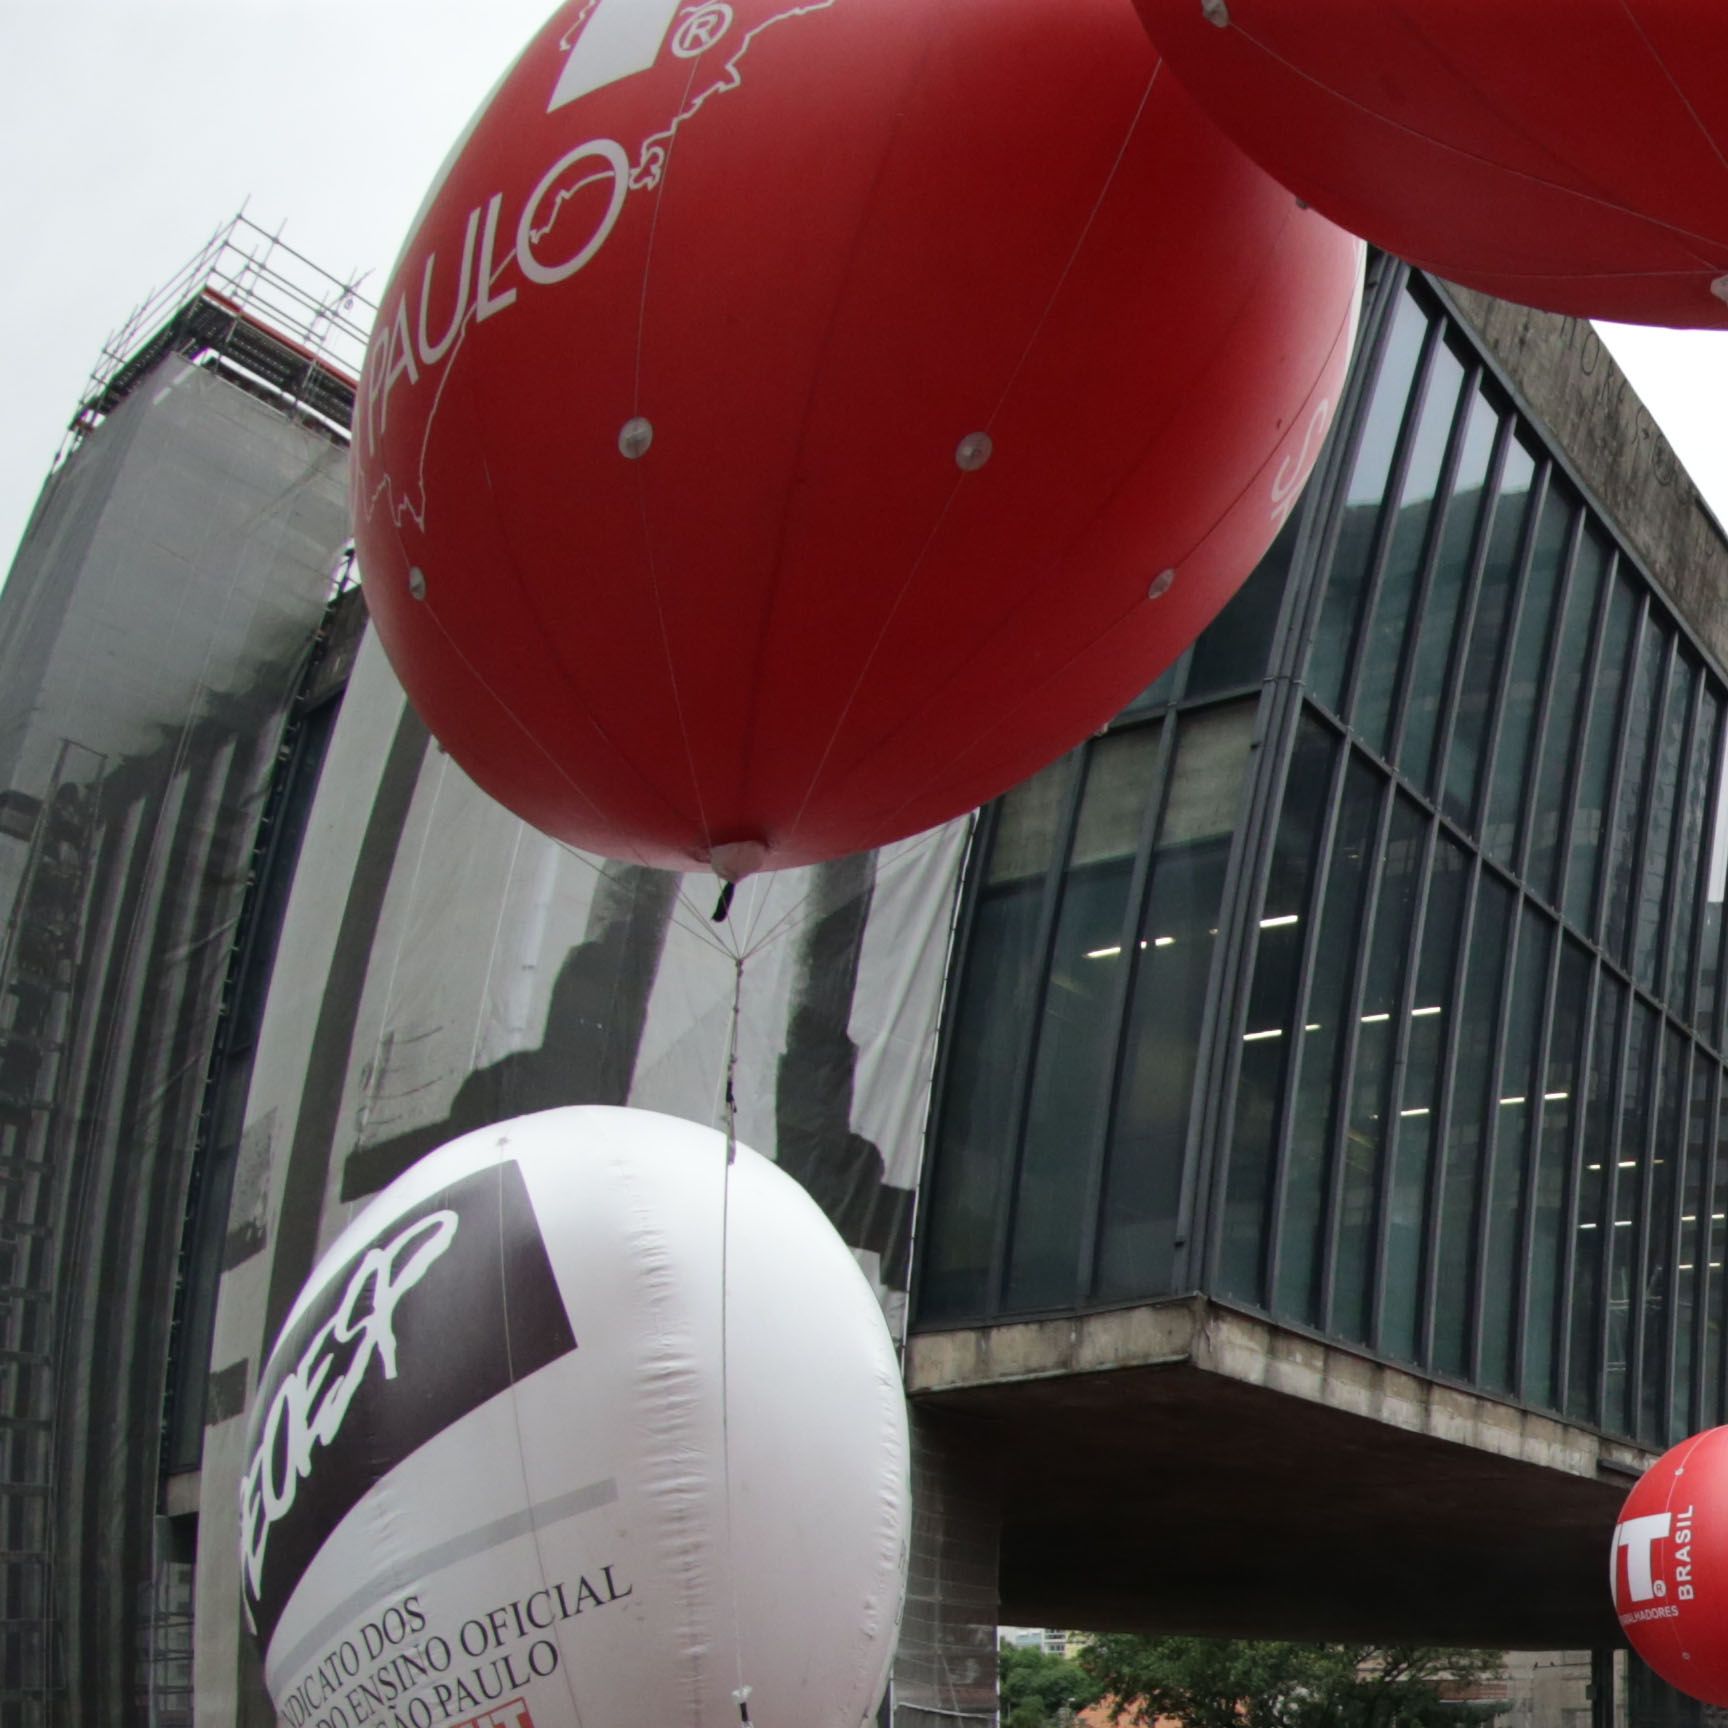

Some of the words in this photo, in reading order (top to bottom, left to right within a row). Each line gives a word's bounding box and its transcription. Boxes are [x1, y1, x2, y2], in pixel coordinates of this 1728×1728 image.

[1674, 1505, 1694, 1601] BRASIL
[353, 1636, 452, 1728] ENSINO
[460, 1565, 634, 1657] OFICIAL
[362, 1594, 427, 1662] DOS
[436, 1640, 559, 1718] PAULO
